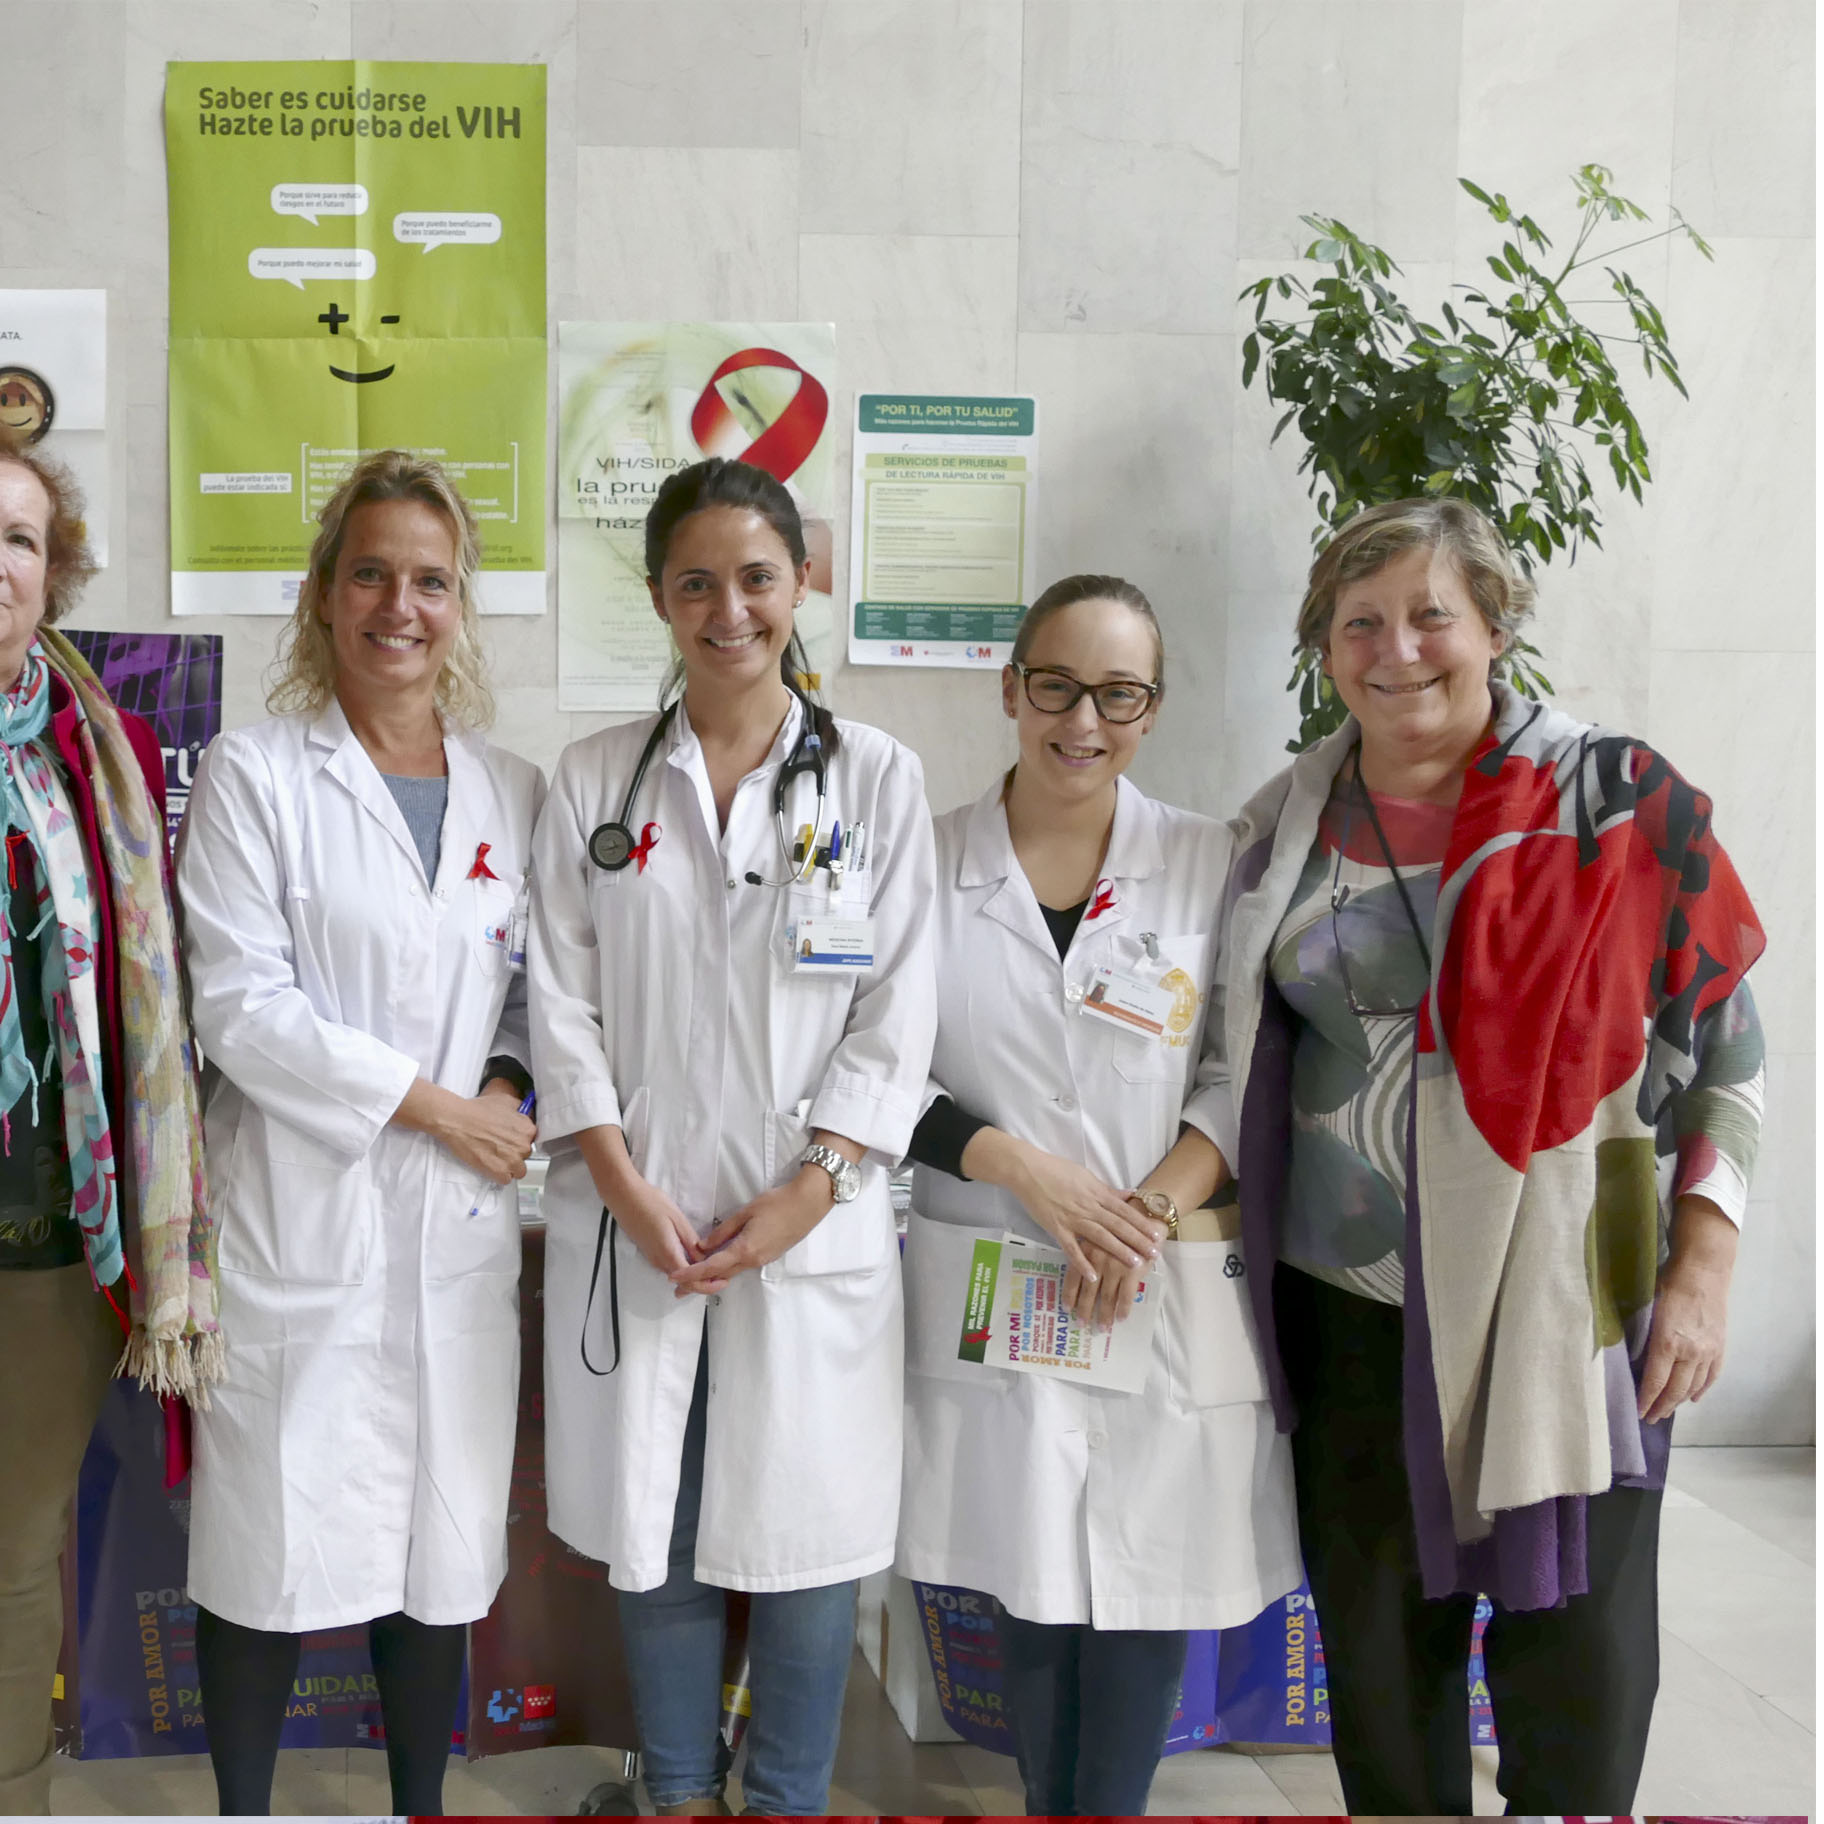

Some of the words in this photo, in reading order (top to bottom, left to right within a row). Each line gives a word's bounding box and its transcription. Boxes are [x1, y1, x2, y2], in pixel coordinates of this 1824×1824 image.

[199, 87, 274, 110] Saber
[280, 92, 309, 110] es
[315, 86, 426, 111] cuidarse
[200, 113, 273, 136] Hazte
[280, 113, 303, 137] la
[311, 115, 402, 141] prueba
[410, 115, 450, 138] del
[456, 106, 521, 139] VIH
[910, 406, 922, 416] TI,
[927, 406, 951, 416] POR
[955, 406, 970, 416] TU
[596, 458, 690, 469] VIH/SIDA
[884, 457, 938, 466] SERVICIOS
[942, 458, 957, 467] DE
[959, 458, 1007, 468] PRUEBAS
